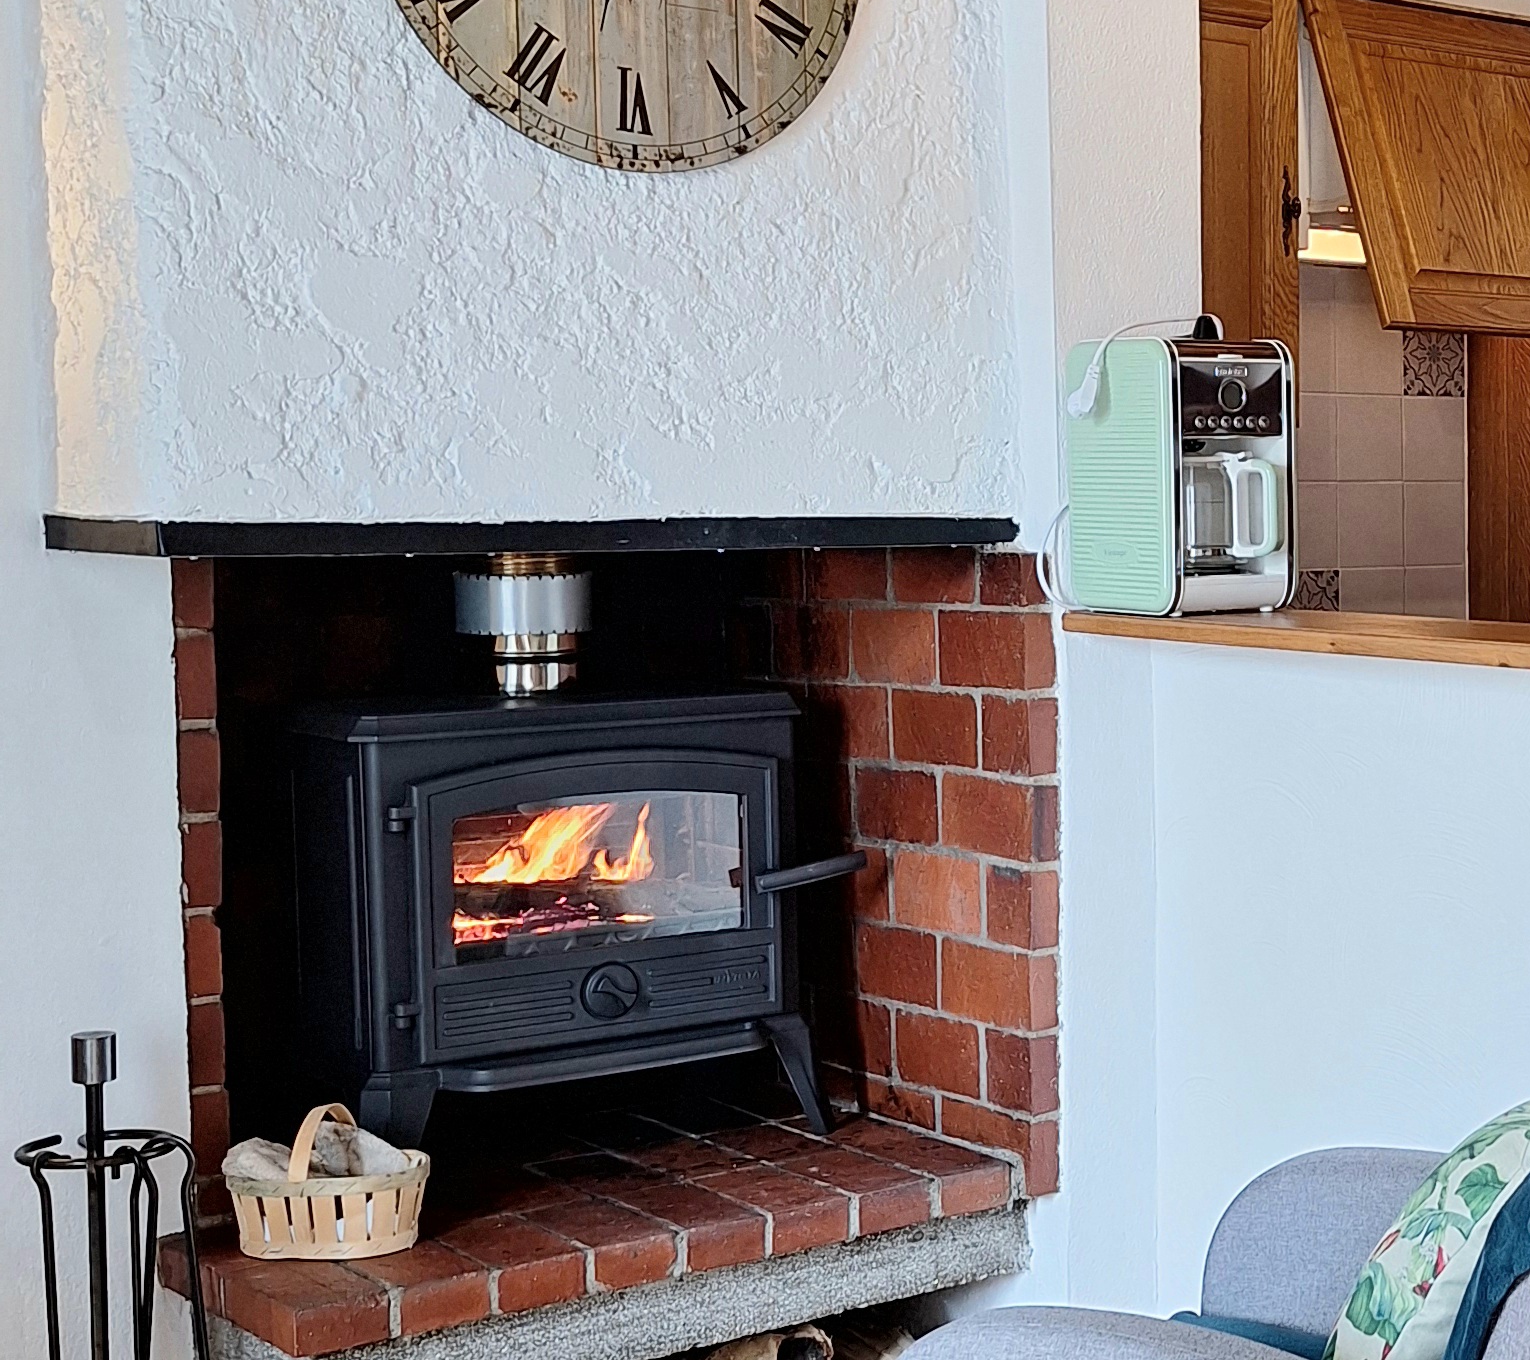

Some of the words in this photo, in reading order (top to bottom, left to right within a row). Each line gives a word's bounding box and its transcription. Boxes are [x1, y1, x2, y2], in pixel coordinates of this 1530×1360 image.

[502, 22, 566, 106] VII
[706, 59, 748, 119] V
[616, 66, 653, 136] VI
